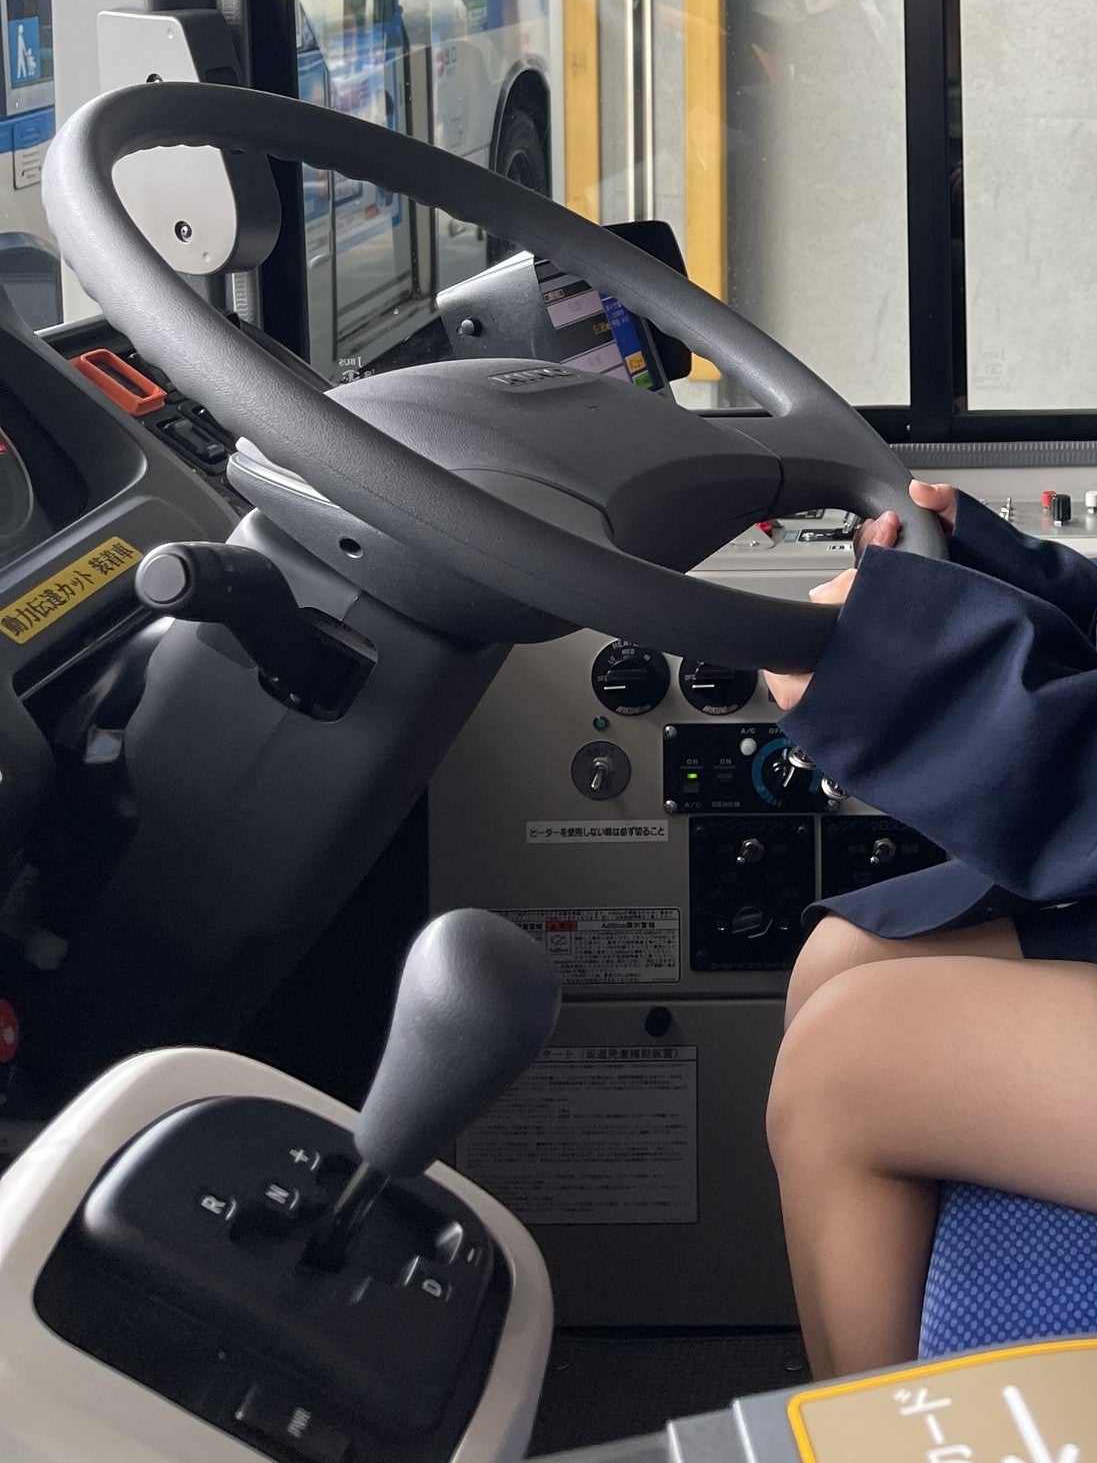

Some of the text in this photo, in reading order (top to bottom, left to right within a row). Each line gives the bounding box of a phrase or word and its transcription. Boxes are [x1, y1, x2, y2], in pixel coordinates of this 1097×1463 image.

[0, 543, 134, 637] 動力伝達カット 装着車
[200, 1194, 226, 1215] R
[265, 1184, 290, 1204] N
[421, 1277, 443, 1298] D
